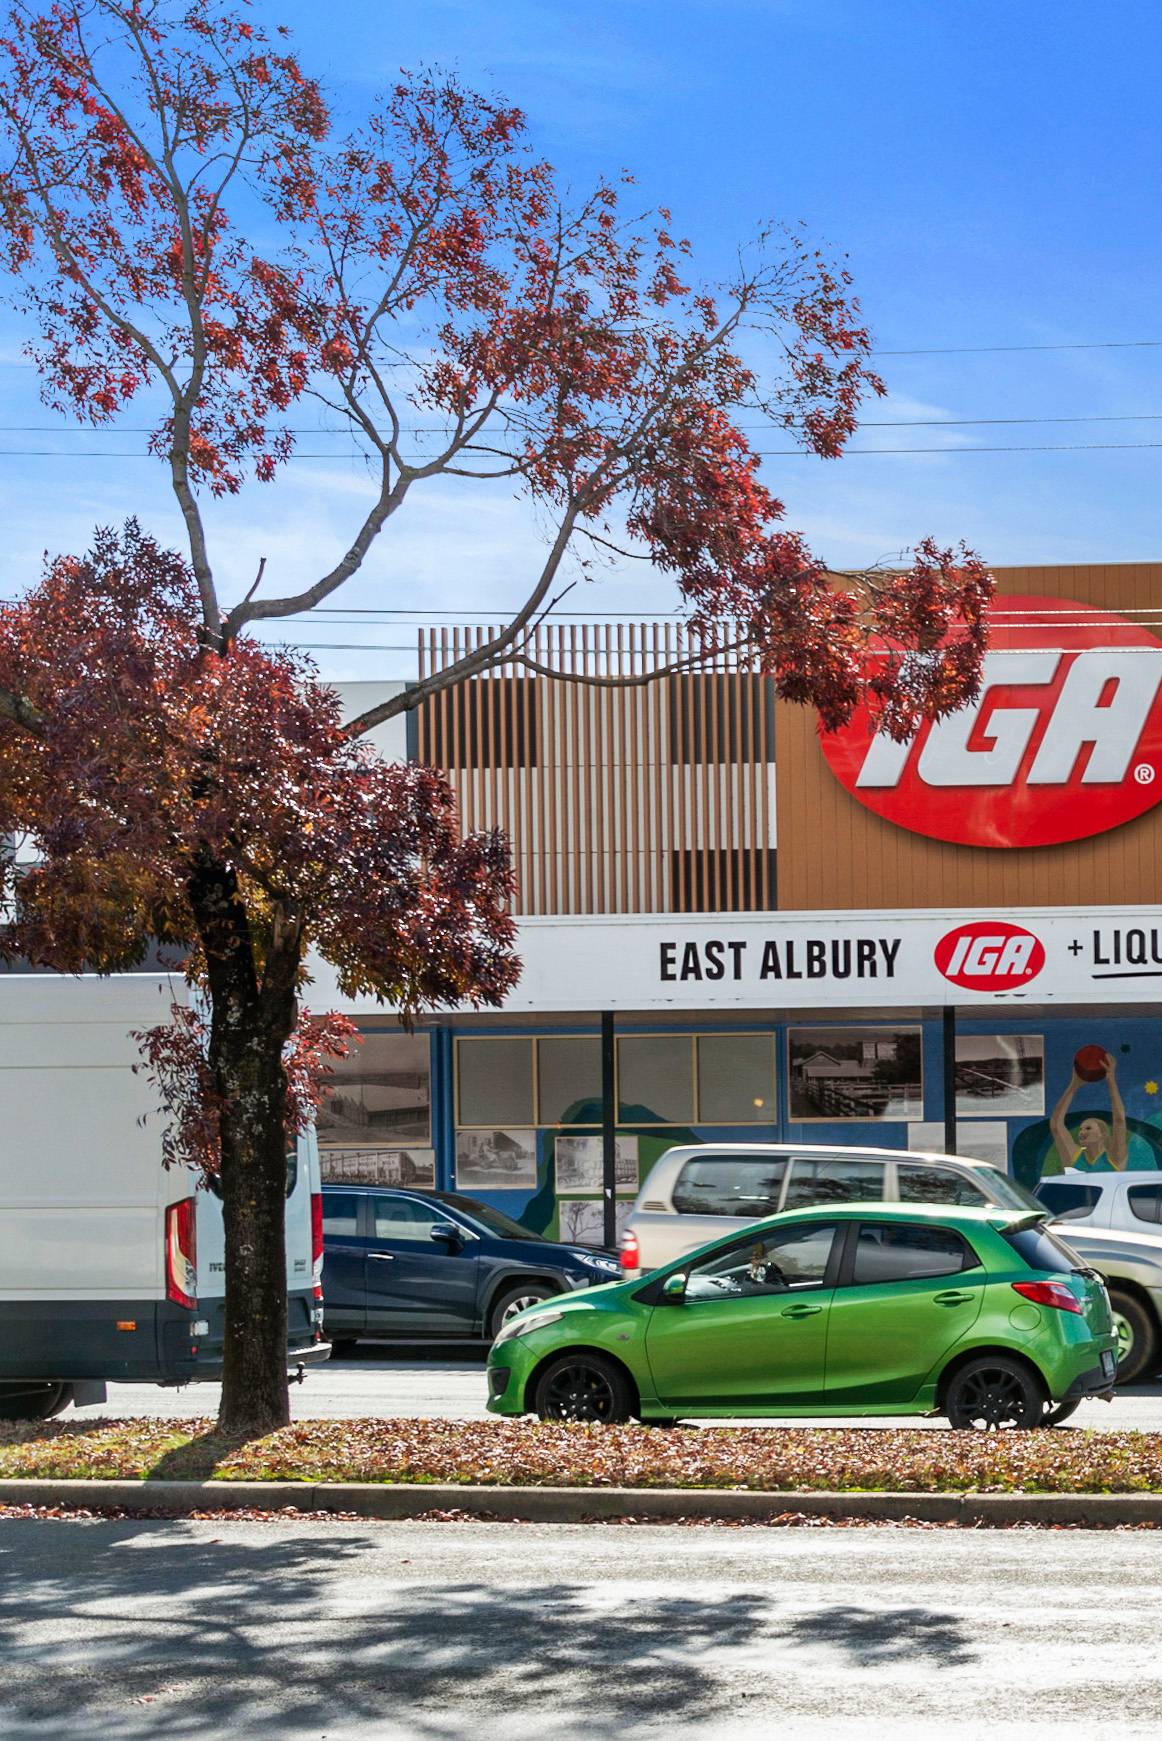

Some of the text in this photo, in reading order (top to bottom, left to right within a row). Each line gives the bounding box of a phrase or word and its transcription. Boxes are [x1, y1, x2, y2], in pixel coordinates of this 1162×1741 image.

[659, 940, 747, 981] EAST
[759, 938, 902, 980] ALBURY
[945, 934, 1032, 977] IGA
